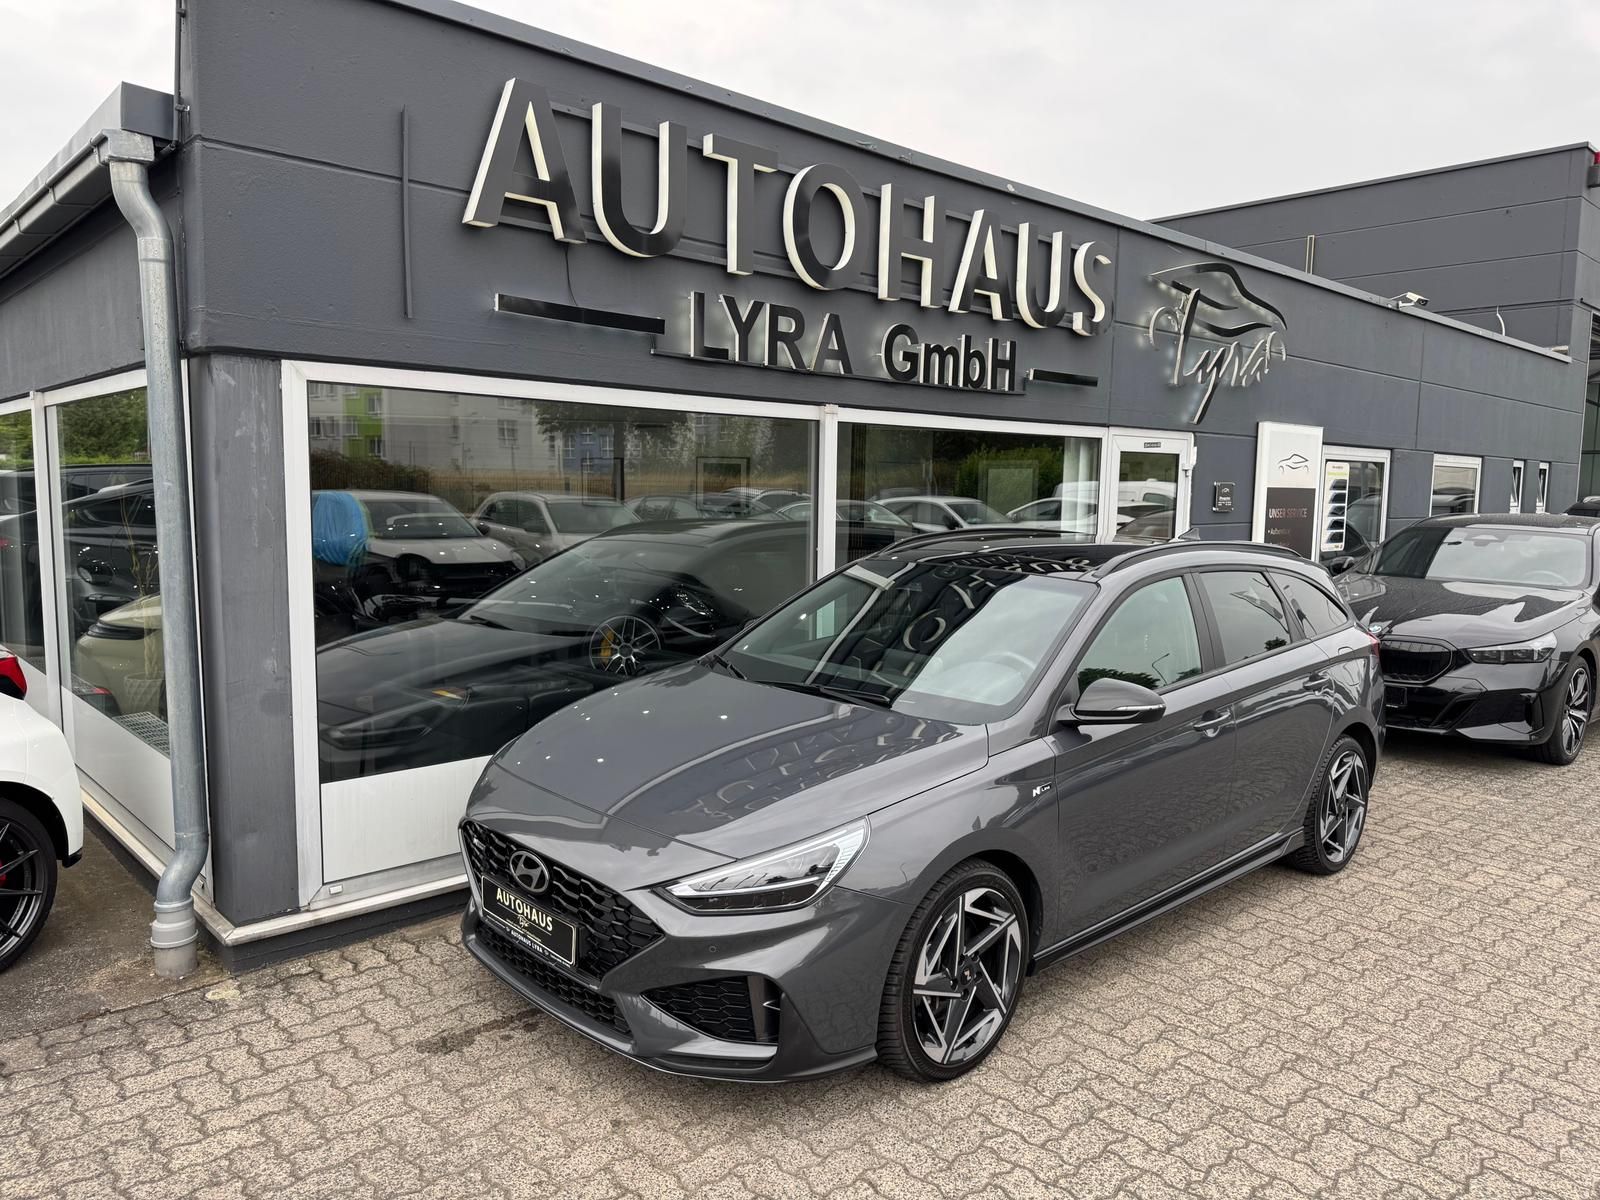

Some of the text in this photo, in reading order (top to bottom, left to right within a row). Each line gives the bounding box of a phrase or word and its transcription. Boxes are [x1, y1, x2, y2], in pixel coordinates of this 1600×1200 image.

[462, 77, 1113, 337] AUTOHAUS
[690, 291, 1017, 392] LYRA GmbH
[496, 887, 553, 932] AUTOHAUS
